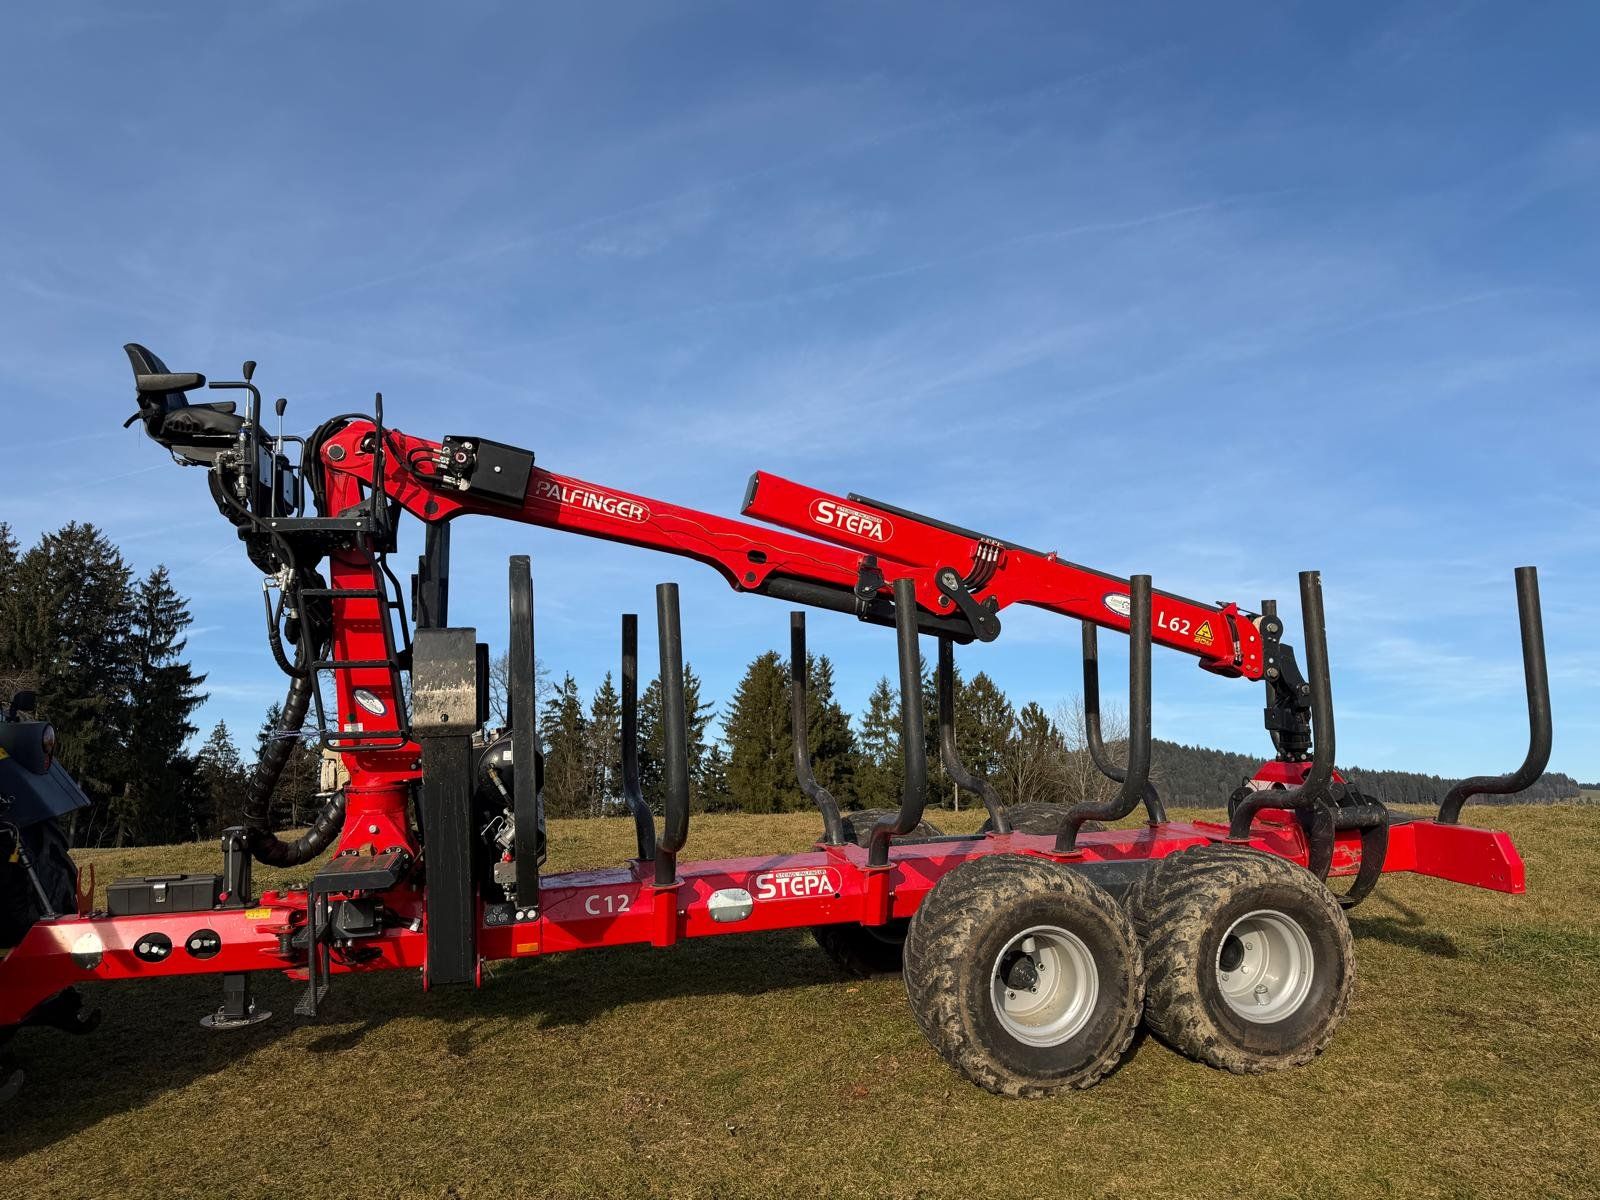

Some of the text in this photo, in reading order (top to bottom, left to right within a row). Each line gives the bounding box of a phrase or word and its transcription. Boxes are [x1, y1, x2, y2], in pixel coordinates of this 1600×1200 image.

[536, 480, 644, 520] PALFINGER
[815, 501, 883, 541] STEPA
[1157, 611, 1191, 635] L62
[756, 872, 834, 899] STEPA
[585, 894, 630, 915] C12
